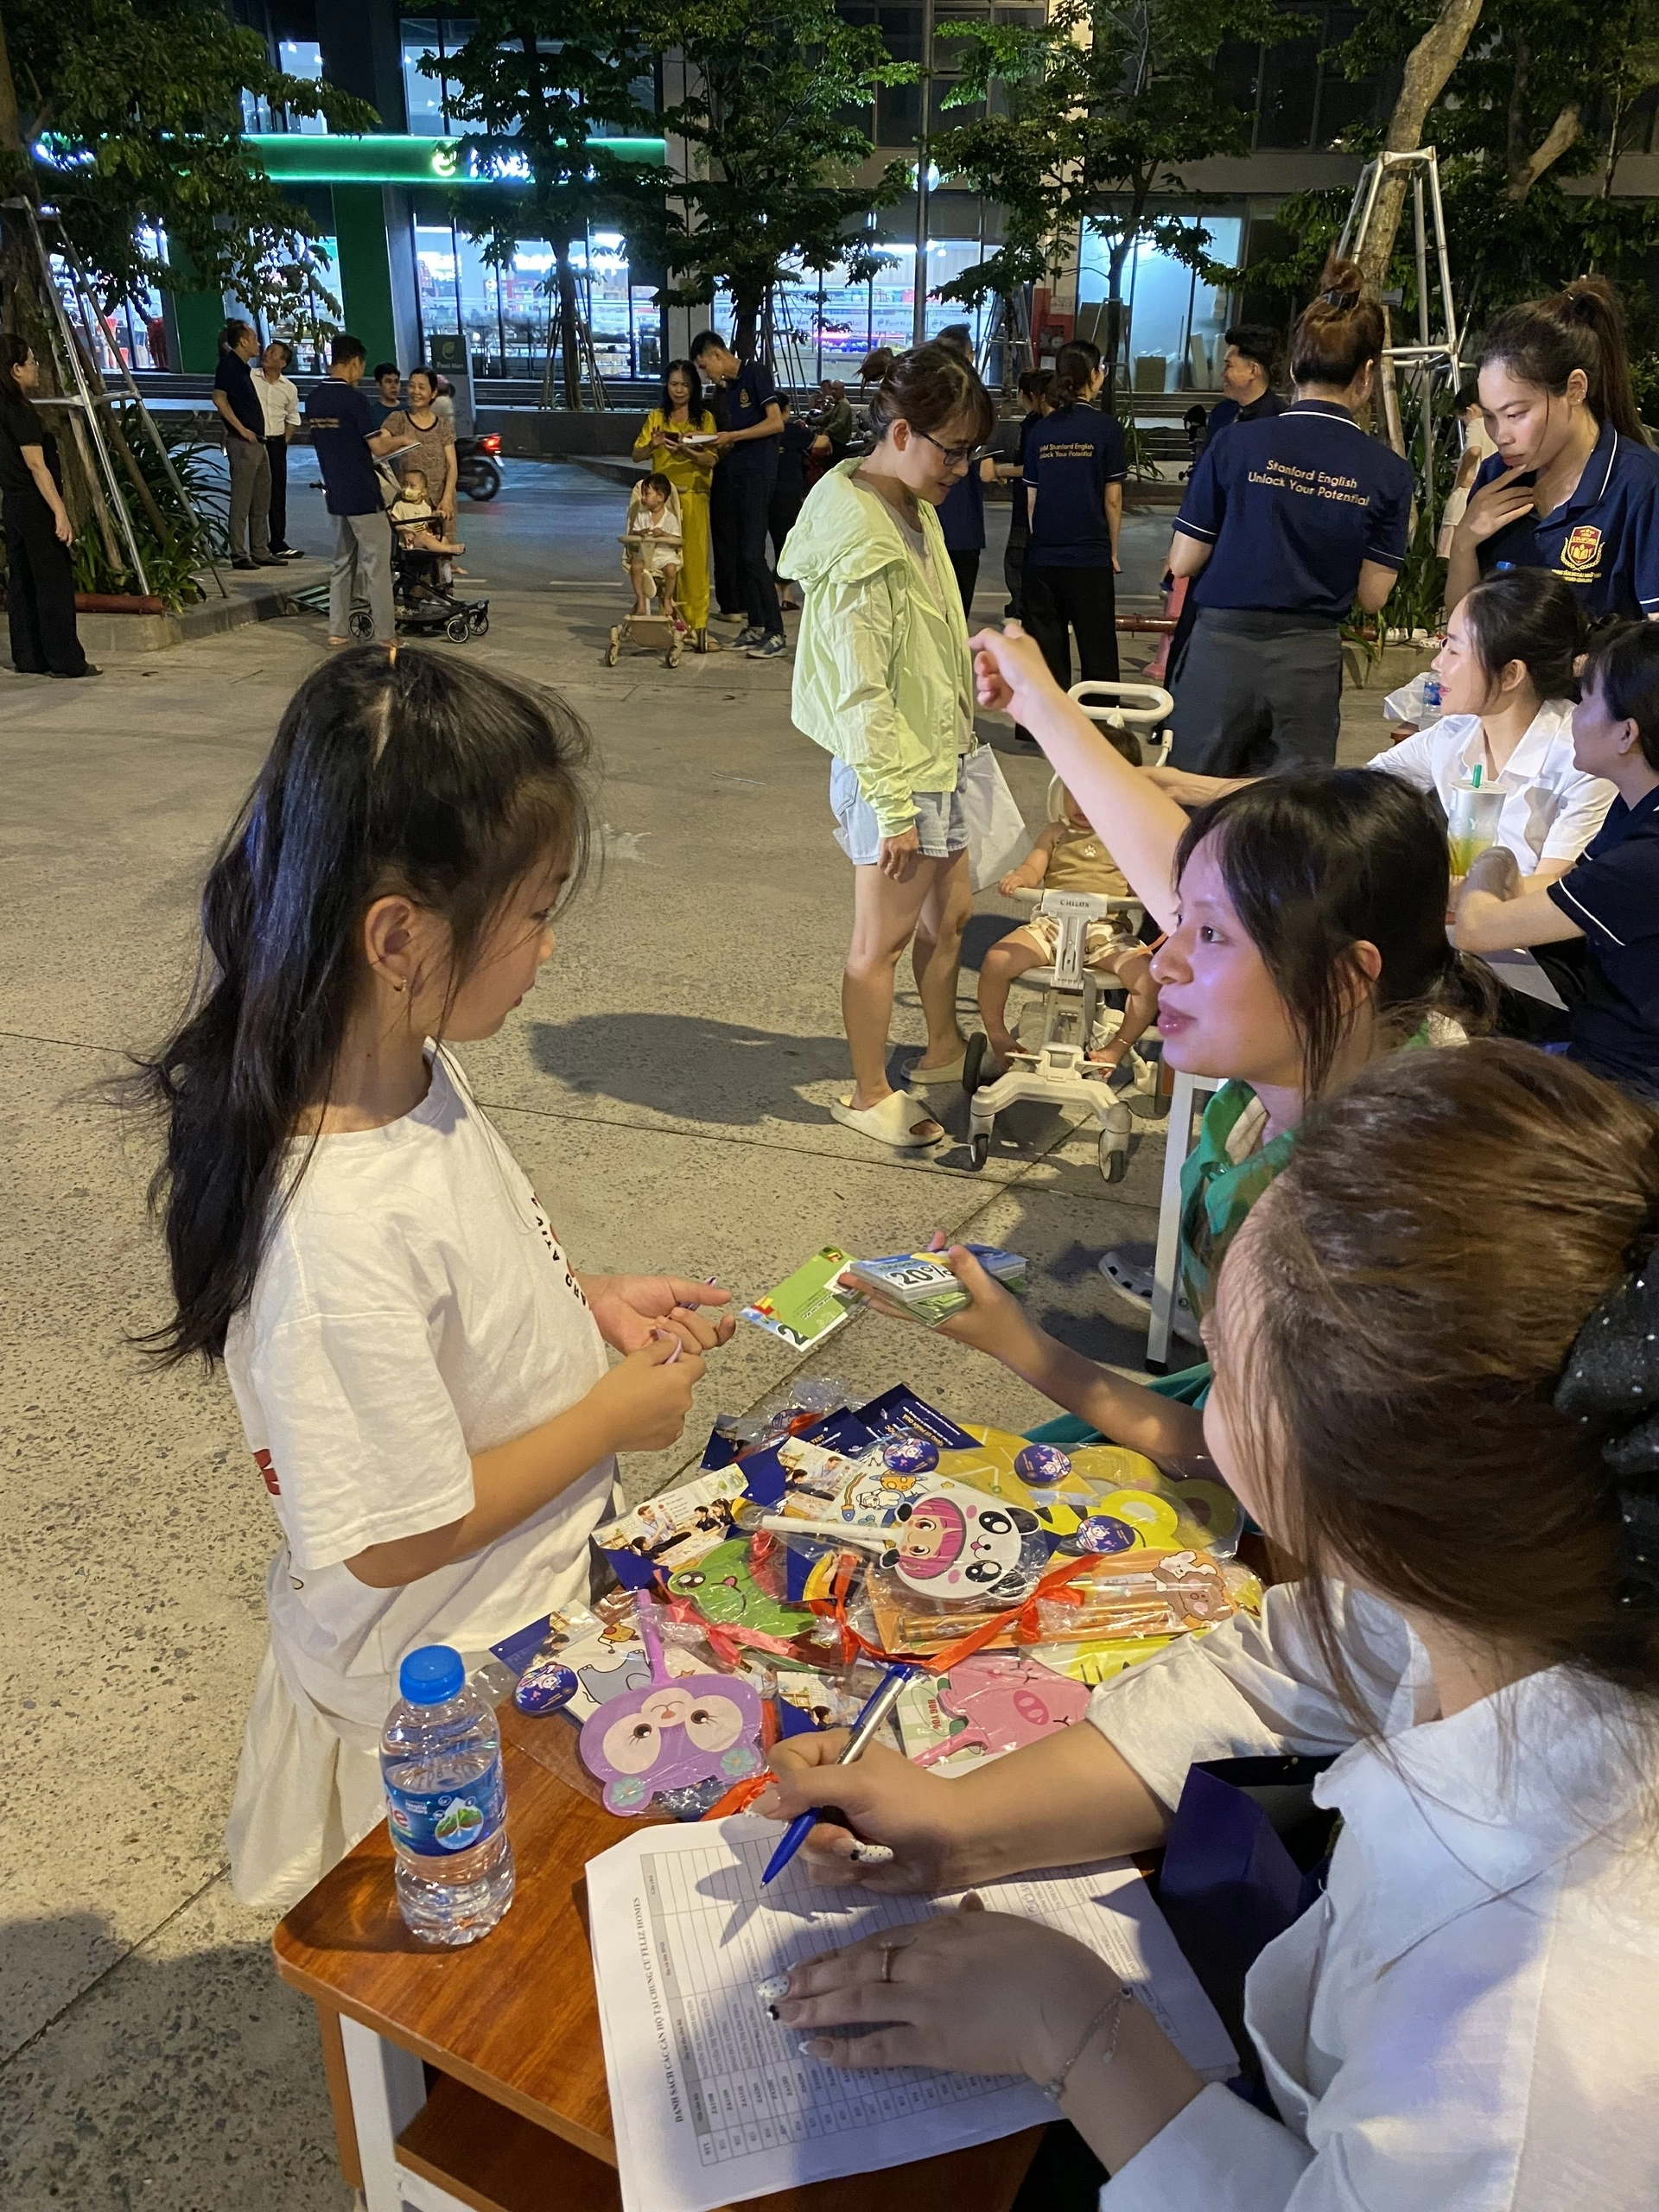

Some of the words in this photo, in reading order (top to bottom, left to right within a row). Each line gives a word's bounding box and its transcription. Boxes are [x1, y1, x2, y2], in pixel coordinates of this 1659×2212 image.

[1267, 460, 1315, 480] Stanford
[1318, 472, 1357, 489] English
[1248, 472, 1285, 486] Unlock
[1289, 480, 1315, 494] Your
[1318, 486, 1370, 505] Potential
[928, 1700, 938, 1713] HUG
[931, 1714, 941, 1729] YOU
[633, 1897, 644, 1929] HOMES
[638, 1930, 649, 1956] FELIZ
[646, 1972, 658, 1999] CHUNG
[662, 2052, 672, 2069] CÁC
[666, 2071, 677, 2095] SÁCH
[671, 2097, 683, 2122] DANH
